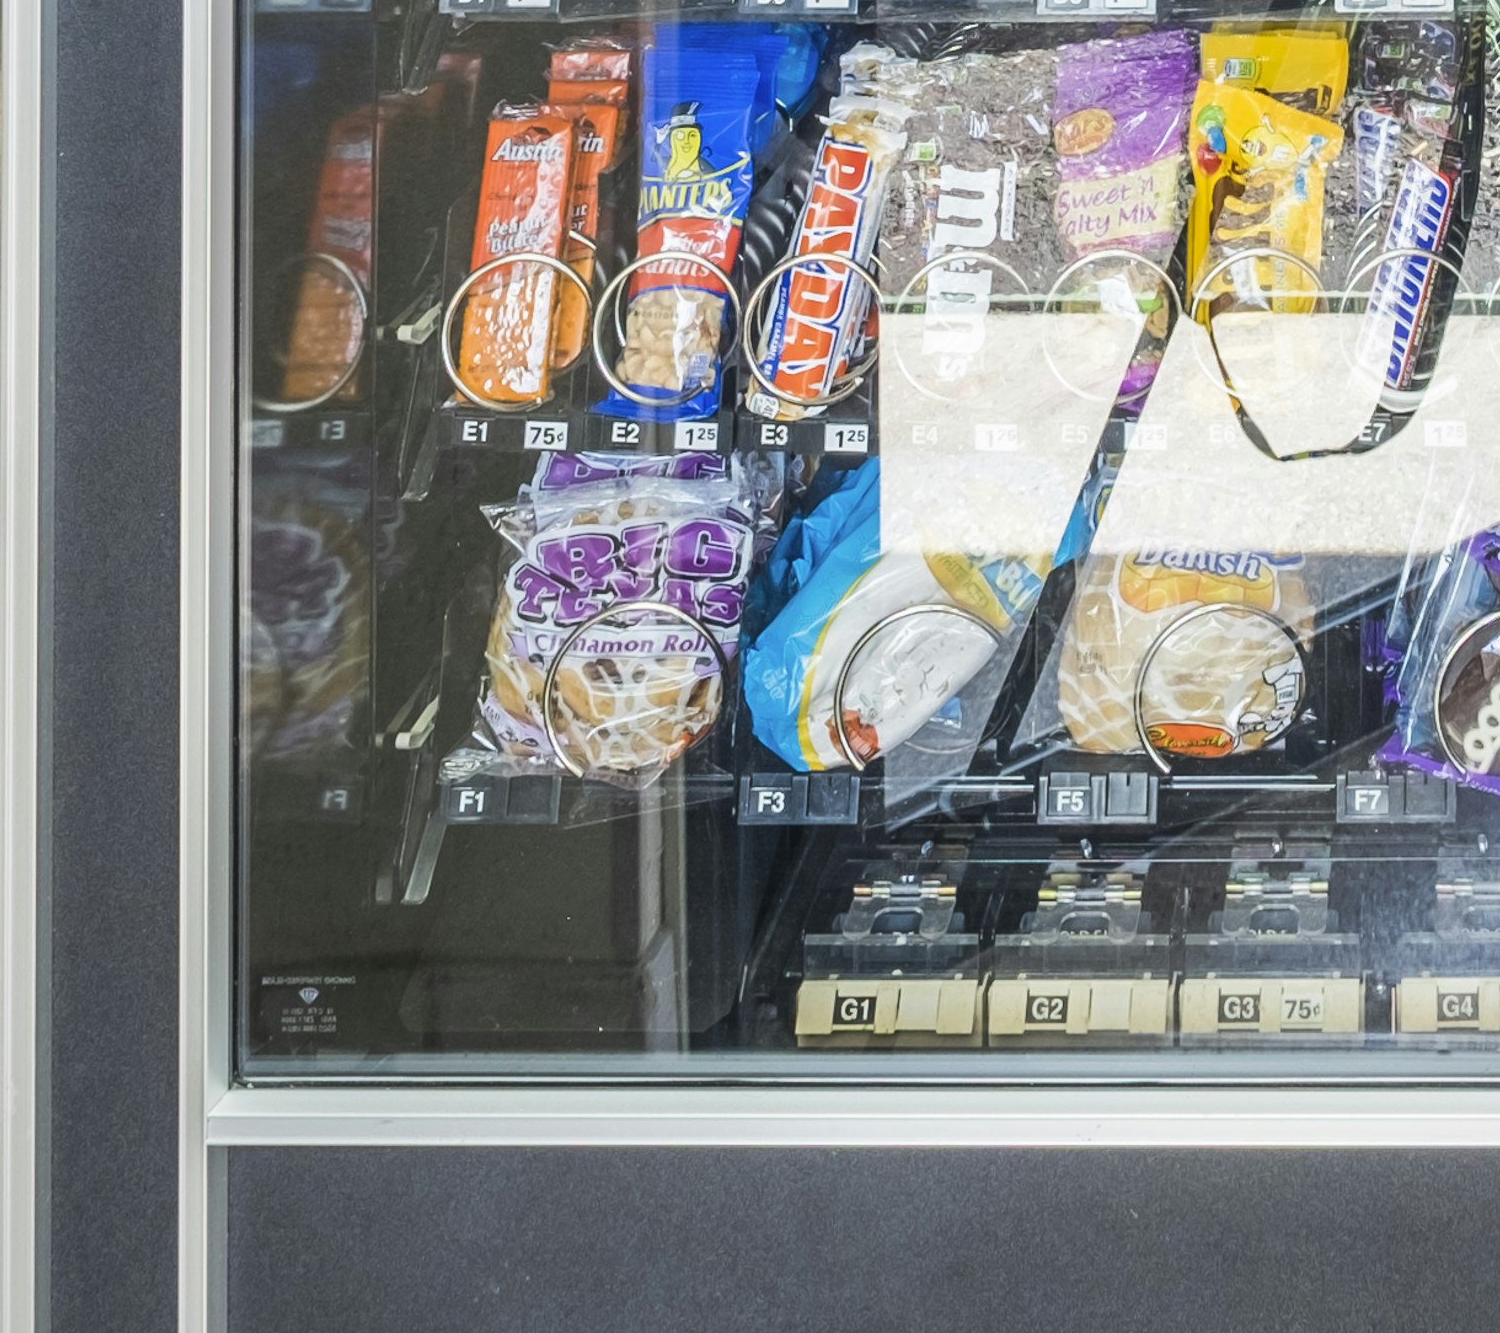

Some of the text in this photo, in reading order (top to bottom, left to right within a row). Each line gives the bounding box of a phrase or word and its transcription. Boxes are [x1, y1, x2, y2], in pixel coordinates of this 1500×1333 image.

[638, 178, 733, 221] ANTERS
[1058, 185, 1130, 219] Sweet
[1059, 206, 1158, 239] alty Mix
[462, 422, 565, 446] E1 75¢
[611, 424, 640, 443] E2
[761, 425, 788, 445] E3
[912, 425, 938, 445] E4
[1061, 423, 1089, 443] E5
[1209, 424, 1236, 444] E6
[1359, 423, 1386, 442] E7
[538, 518, 737, 587] BIG
[1133, 541, 1264, 581] Danish
[662, 634, 708, 653] Roll
[458, 791, 485, 813] F1
[757, 792, 786, 813] F3
[1056, 791, 1085, 812] F5
[1354, 789, 1382, 812] F7
[840, 998, 870, 1023] G1
[1030, 997, 1064, 1021] G2
[1223, 996, 1322, 1020] G3 75¢
[1442, 994, 1474, 1018] G4
